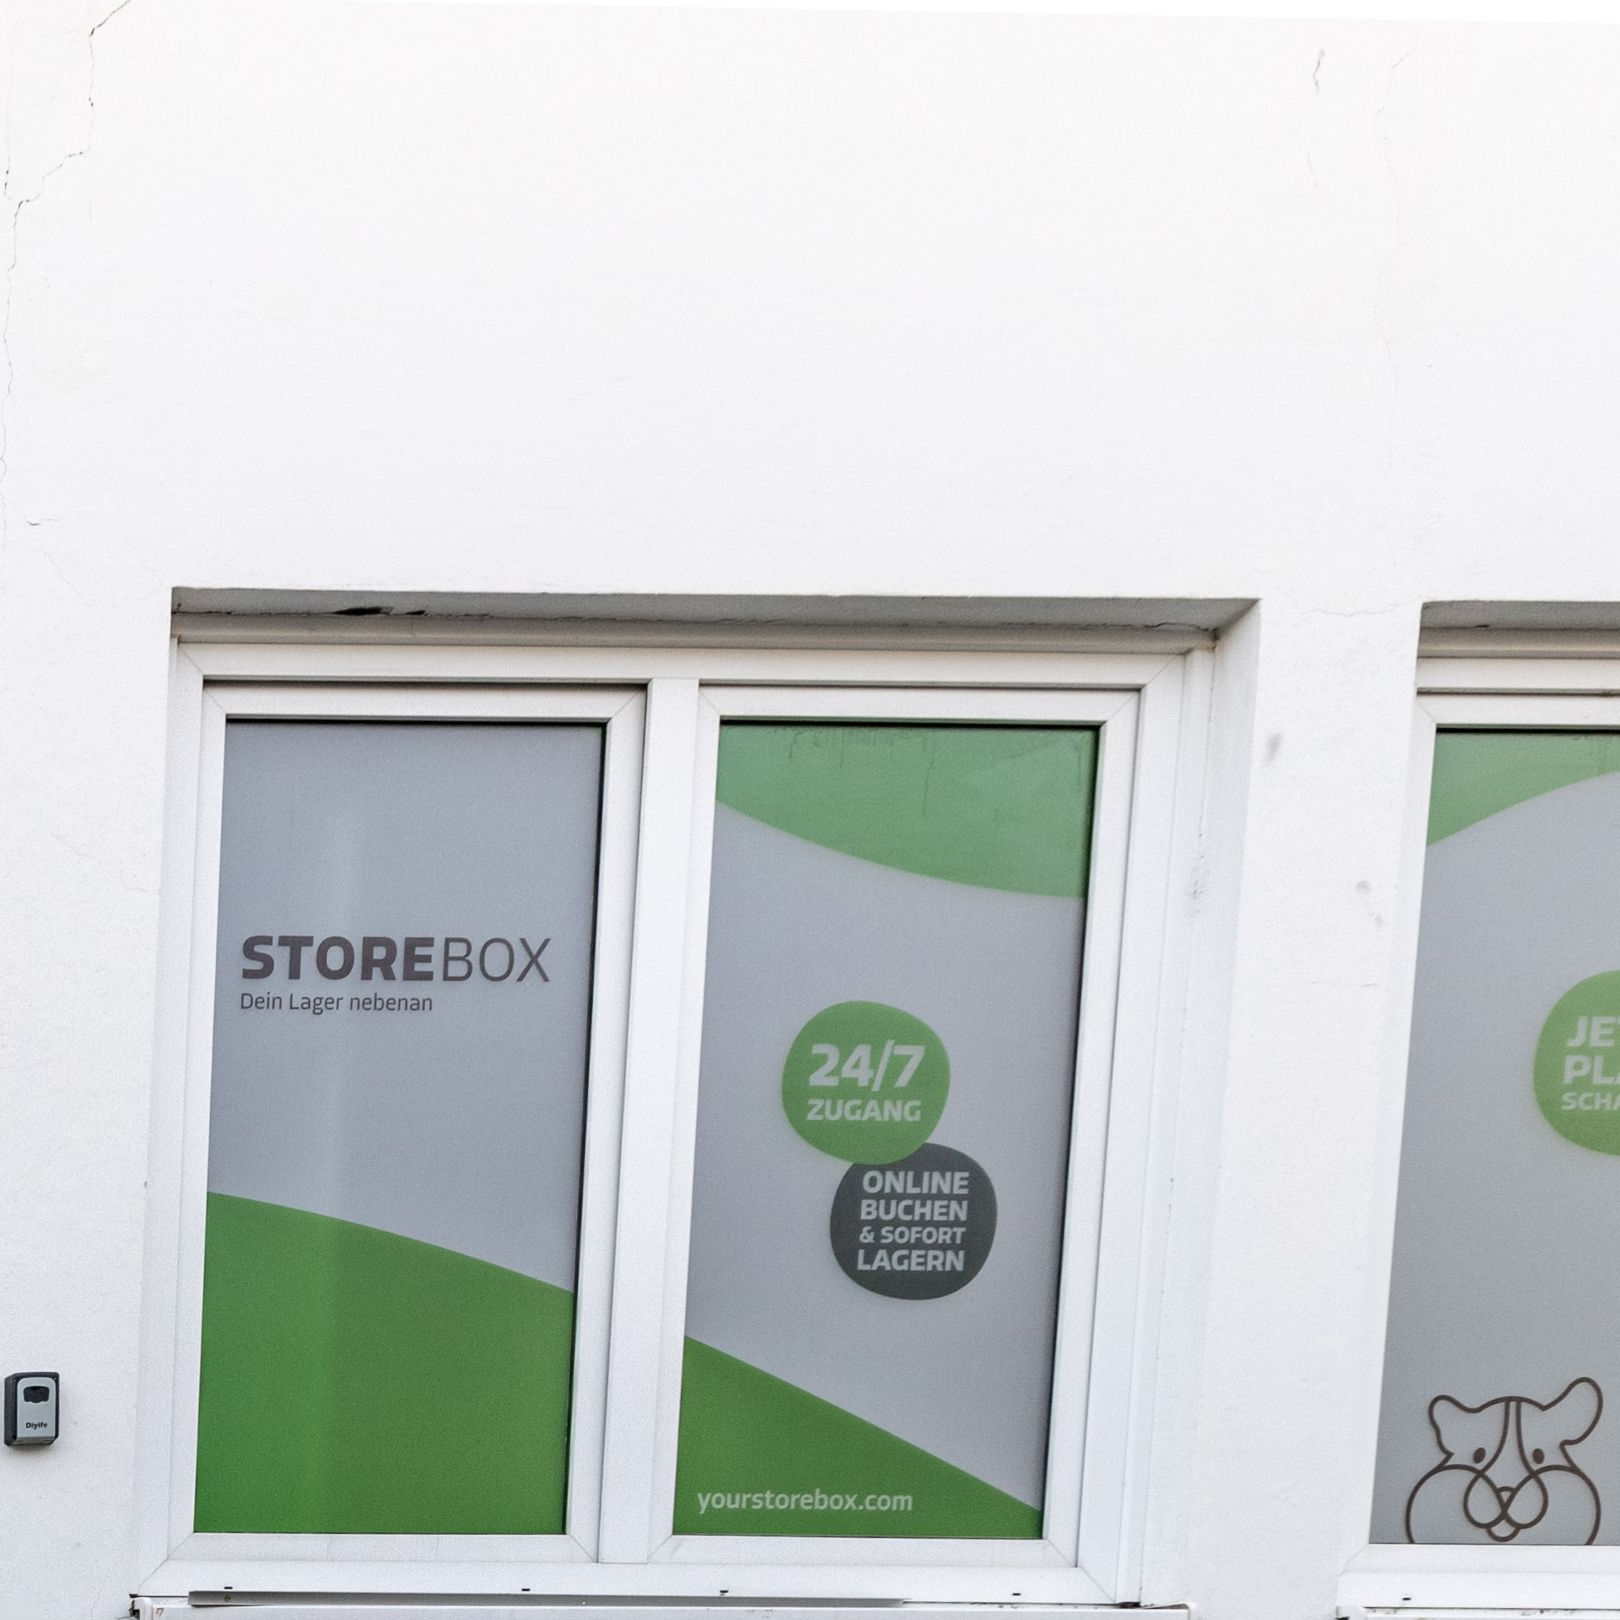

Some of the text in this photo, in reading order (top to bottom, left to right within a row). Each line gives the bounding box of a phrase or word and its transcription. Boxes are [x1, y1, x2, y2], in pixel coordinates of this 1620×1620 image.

[241, 935, 551, 983] STOREBOX
[240, 992, 433, 1016] Dein Lager nebenan
[808, 1039, 926, 1092] 24/7
[806, 1098, 922, 1123] ZUGANG
[862, 1170, 970, 1195] ONLINE
[860, 1199, 968, 1222] BUCHEN
[859, 1225, 967, 1245] & SOFORT
[857, 1249, 965, 1272] LAGERN
[697, 1487, 913, 1515] yourstorebox.com
